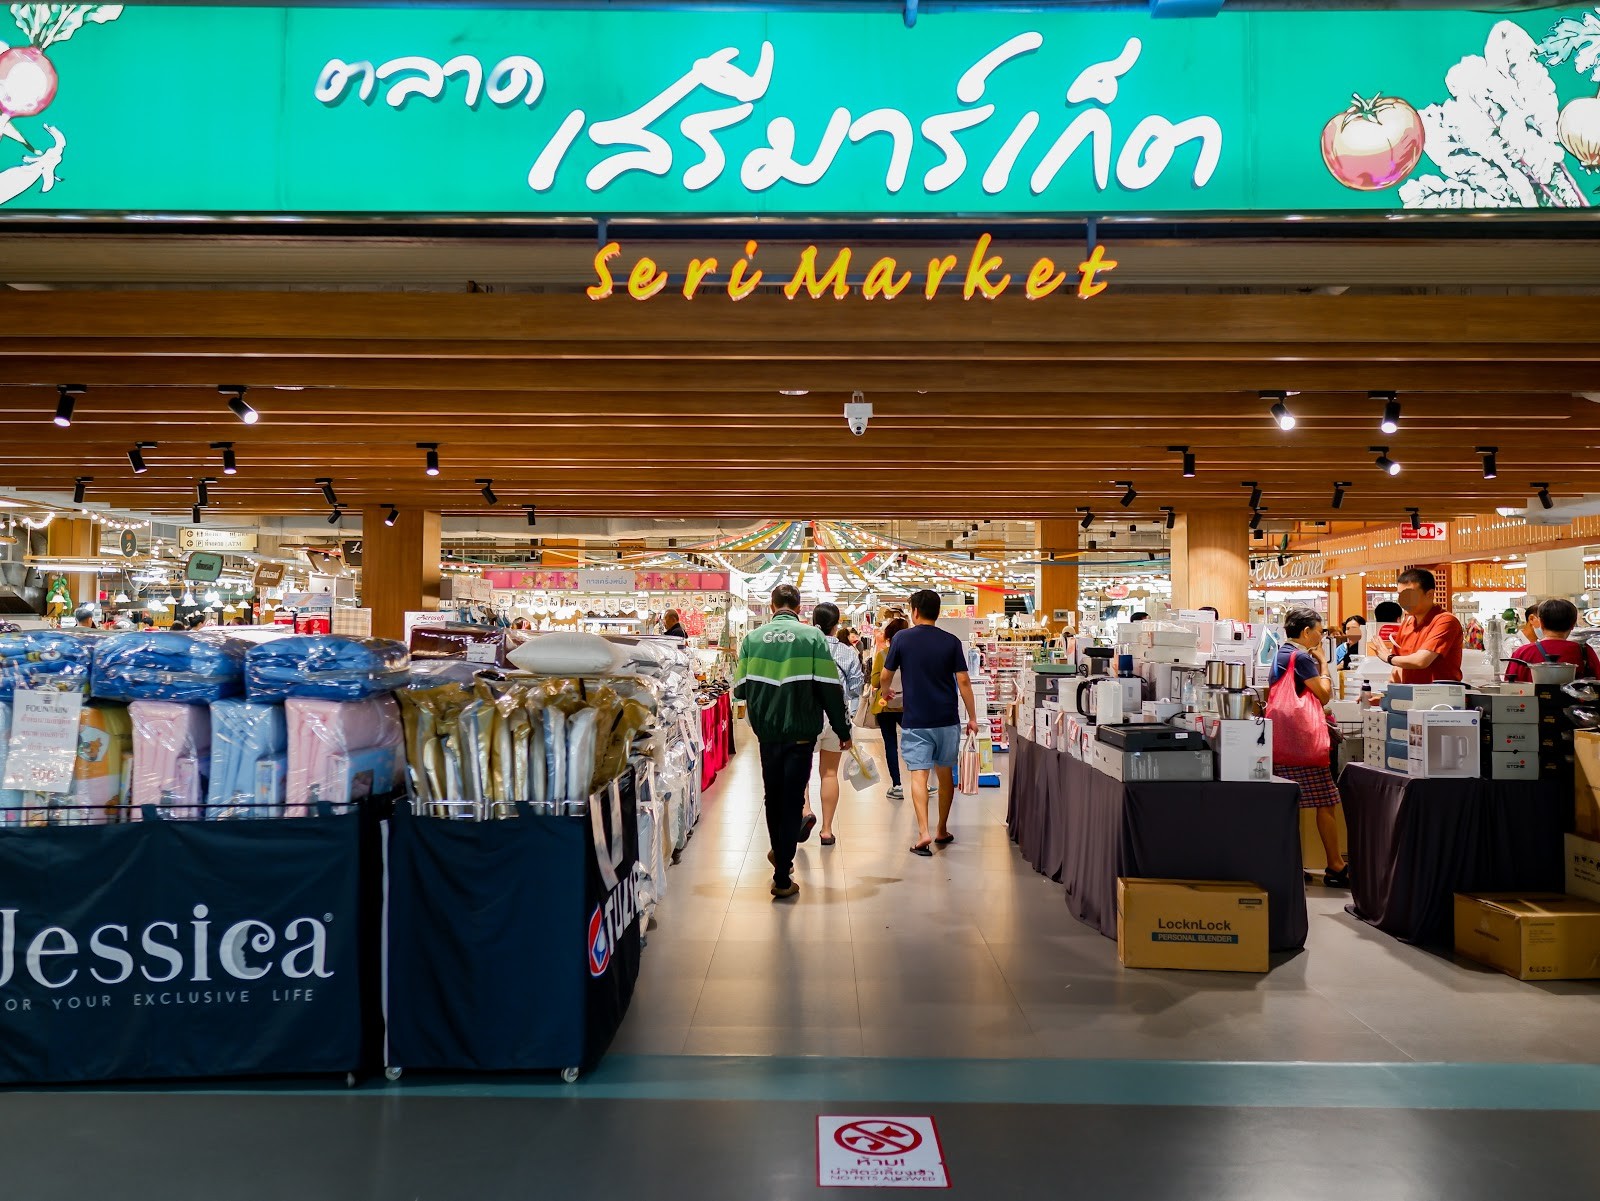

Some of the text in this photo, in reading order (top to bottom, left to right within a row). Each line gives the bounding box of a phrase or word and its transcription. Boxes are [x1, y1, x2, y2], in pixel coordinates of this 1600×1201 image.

[315, 54, 545, 107] ตลาด
[528, 31, 1222, 194] เสรีมาร์เก็ต
[586, 233, 1119, 301] Seri Market
[125, 542, 132, 552] 2
[1290, 559, 1326, 577] corner
[762, 630, 796, 644] Grab
[1158, 917, 1231, 931] LocknLock
[0, 904, 335, 988] Jessica
[1157, 933, 1232, 943] PERSONAL BLENDER
[52, 994, 112, 1010] YOUR
[133, 990, 250, 1006] EXCLUSIVE
[273, 988, 315, 1002] LIFE
[856, 1156, 905, 1167] ห้าม!
